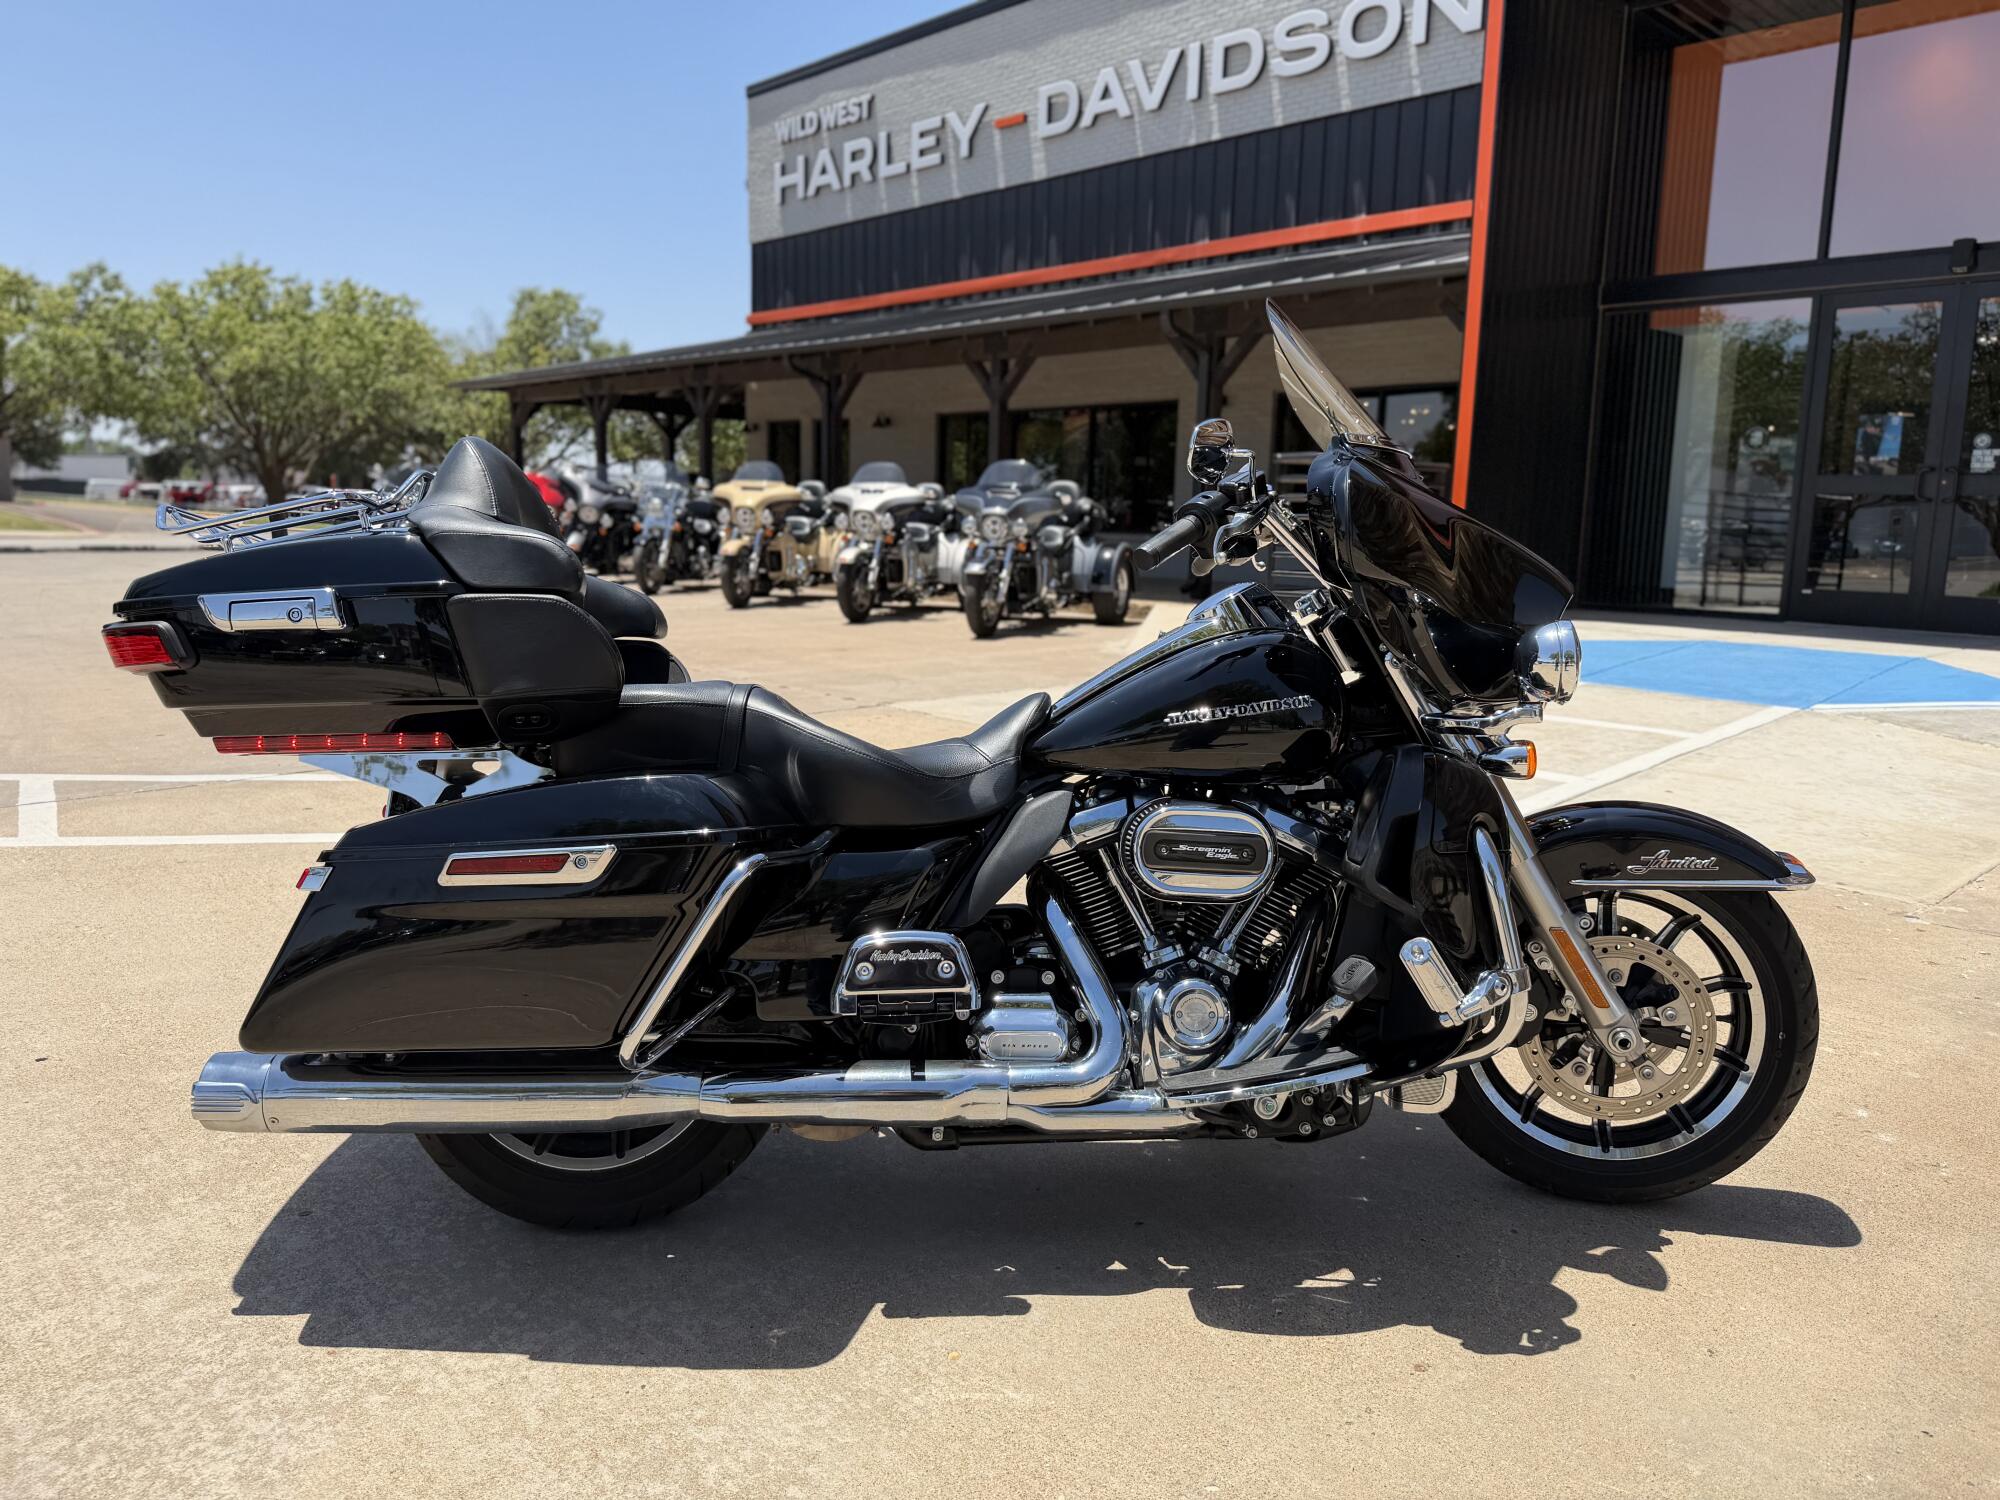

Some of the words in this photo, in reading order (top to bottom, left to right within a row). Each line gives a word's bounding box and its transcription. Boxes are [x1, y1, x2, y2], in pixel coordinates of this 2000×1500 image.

[774, 111, 820, 144] WILD
[819, 93, 875, 130] WEST
[1206, 851, 1239, 860] Eagle
[1626, 849, 1719, 875] Limited
